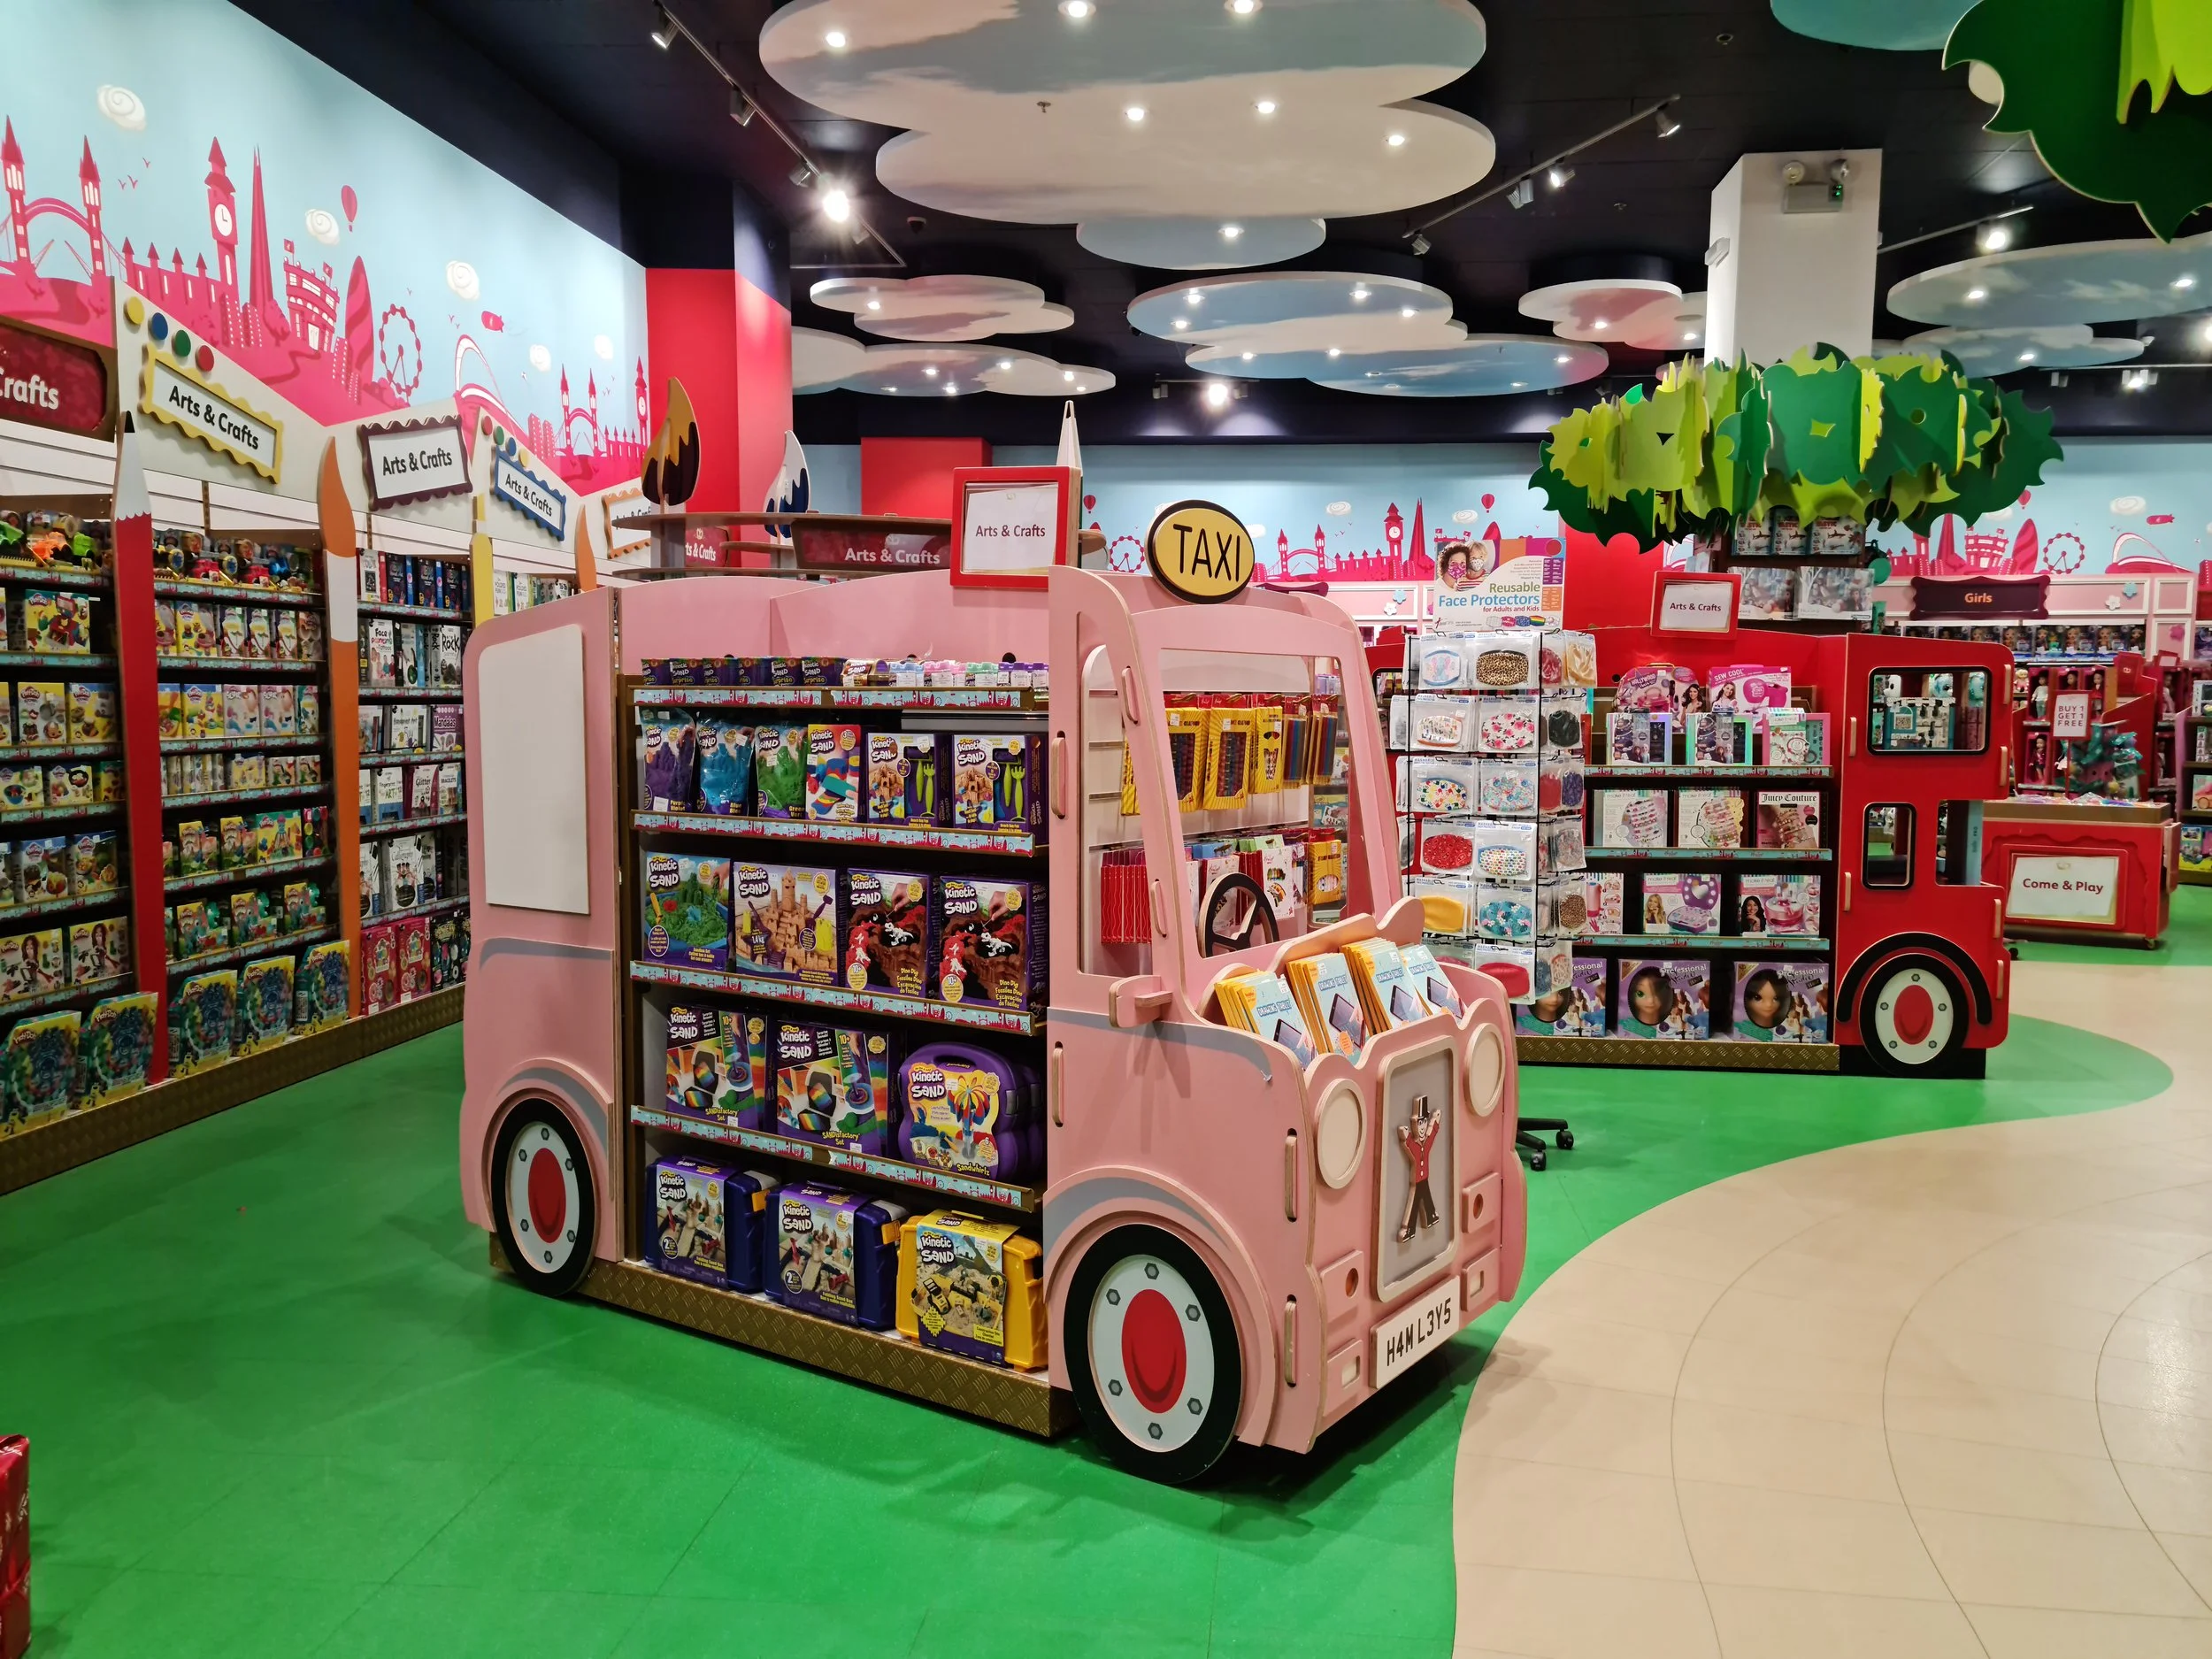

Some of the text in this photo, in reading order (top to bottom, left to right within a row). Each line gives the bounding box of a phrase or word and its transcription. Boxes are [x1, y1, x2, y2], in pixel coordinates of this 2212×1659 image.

[169, 385, 259, 450] Arts & Crafts
[383, 448, 453, 477] Arts & Crafts
[505, 473, 553, 518] Arts & Crafts
[975, 524, 1046, 538] Arts & Crafts
[693, 542, 717, 561] & Crafts
[845, 547, 941, 565] Arts & Crafts
[1173, 523, 1241, 583] TAXI
[1489, 581, 1540, 594] Reusable
[1439, 595, 1467, 607] Face
[1471, 594, 1540, 607] Protectors
[1964, 592, 1993, 604] Girls
[1698, 603, 1722, 612] Crafts
[1715, 669, 1743, 682] SEW COOL
[1762, 793, 1817, 803] Juicy Couture
[2023, 878, 2104, 895] Come & Play
[1571, 962, 1603, 972] fessional
[1386, 1297, 1451, 1367] H4M L3Y5
